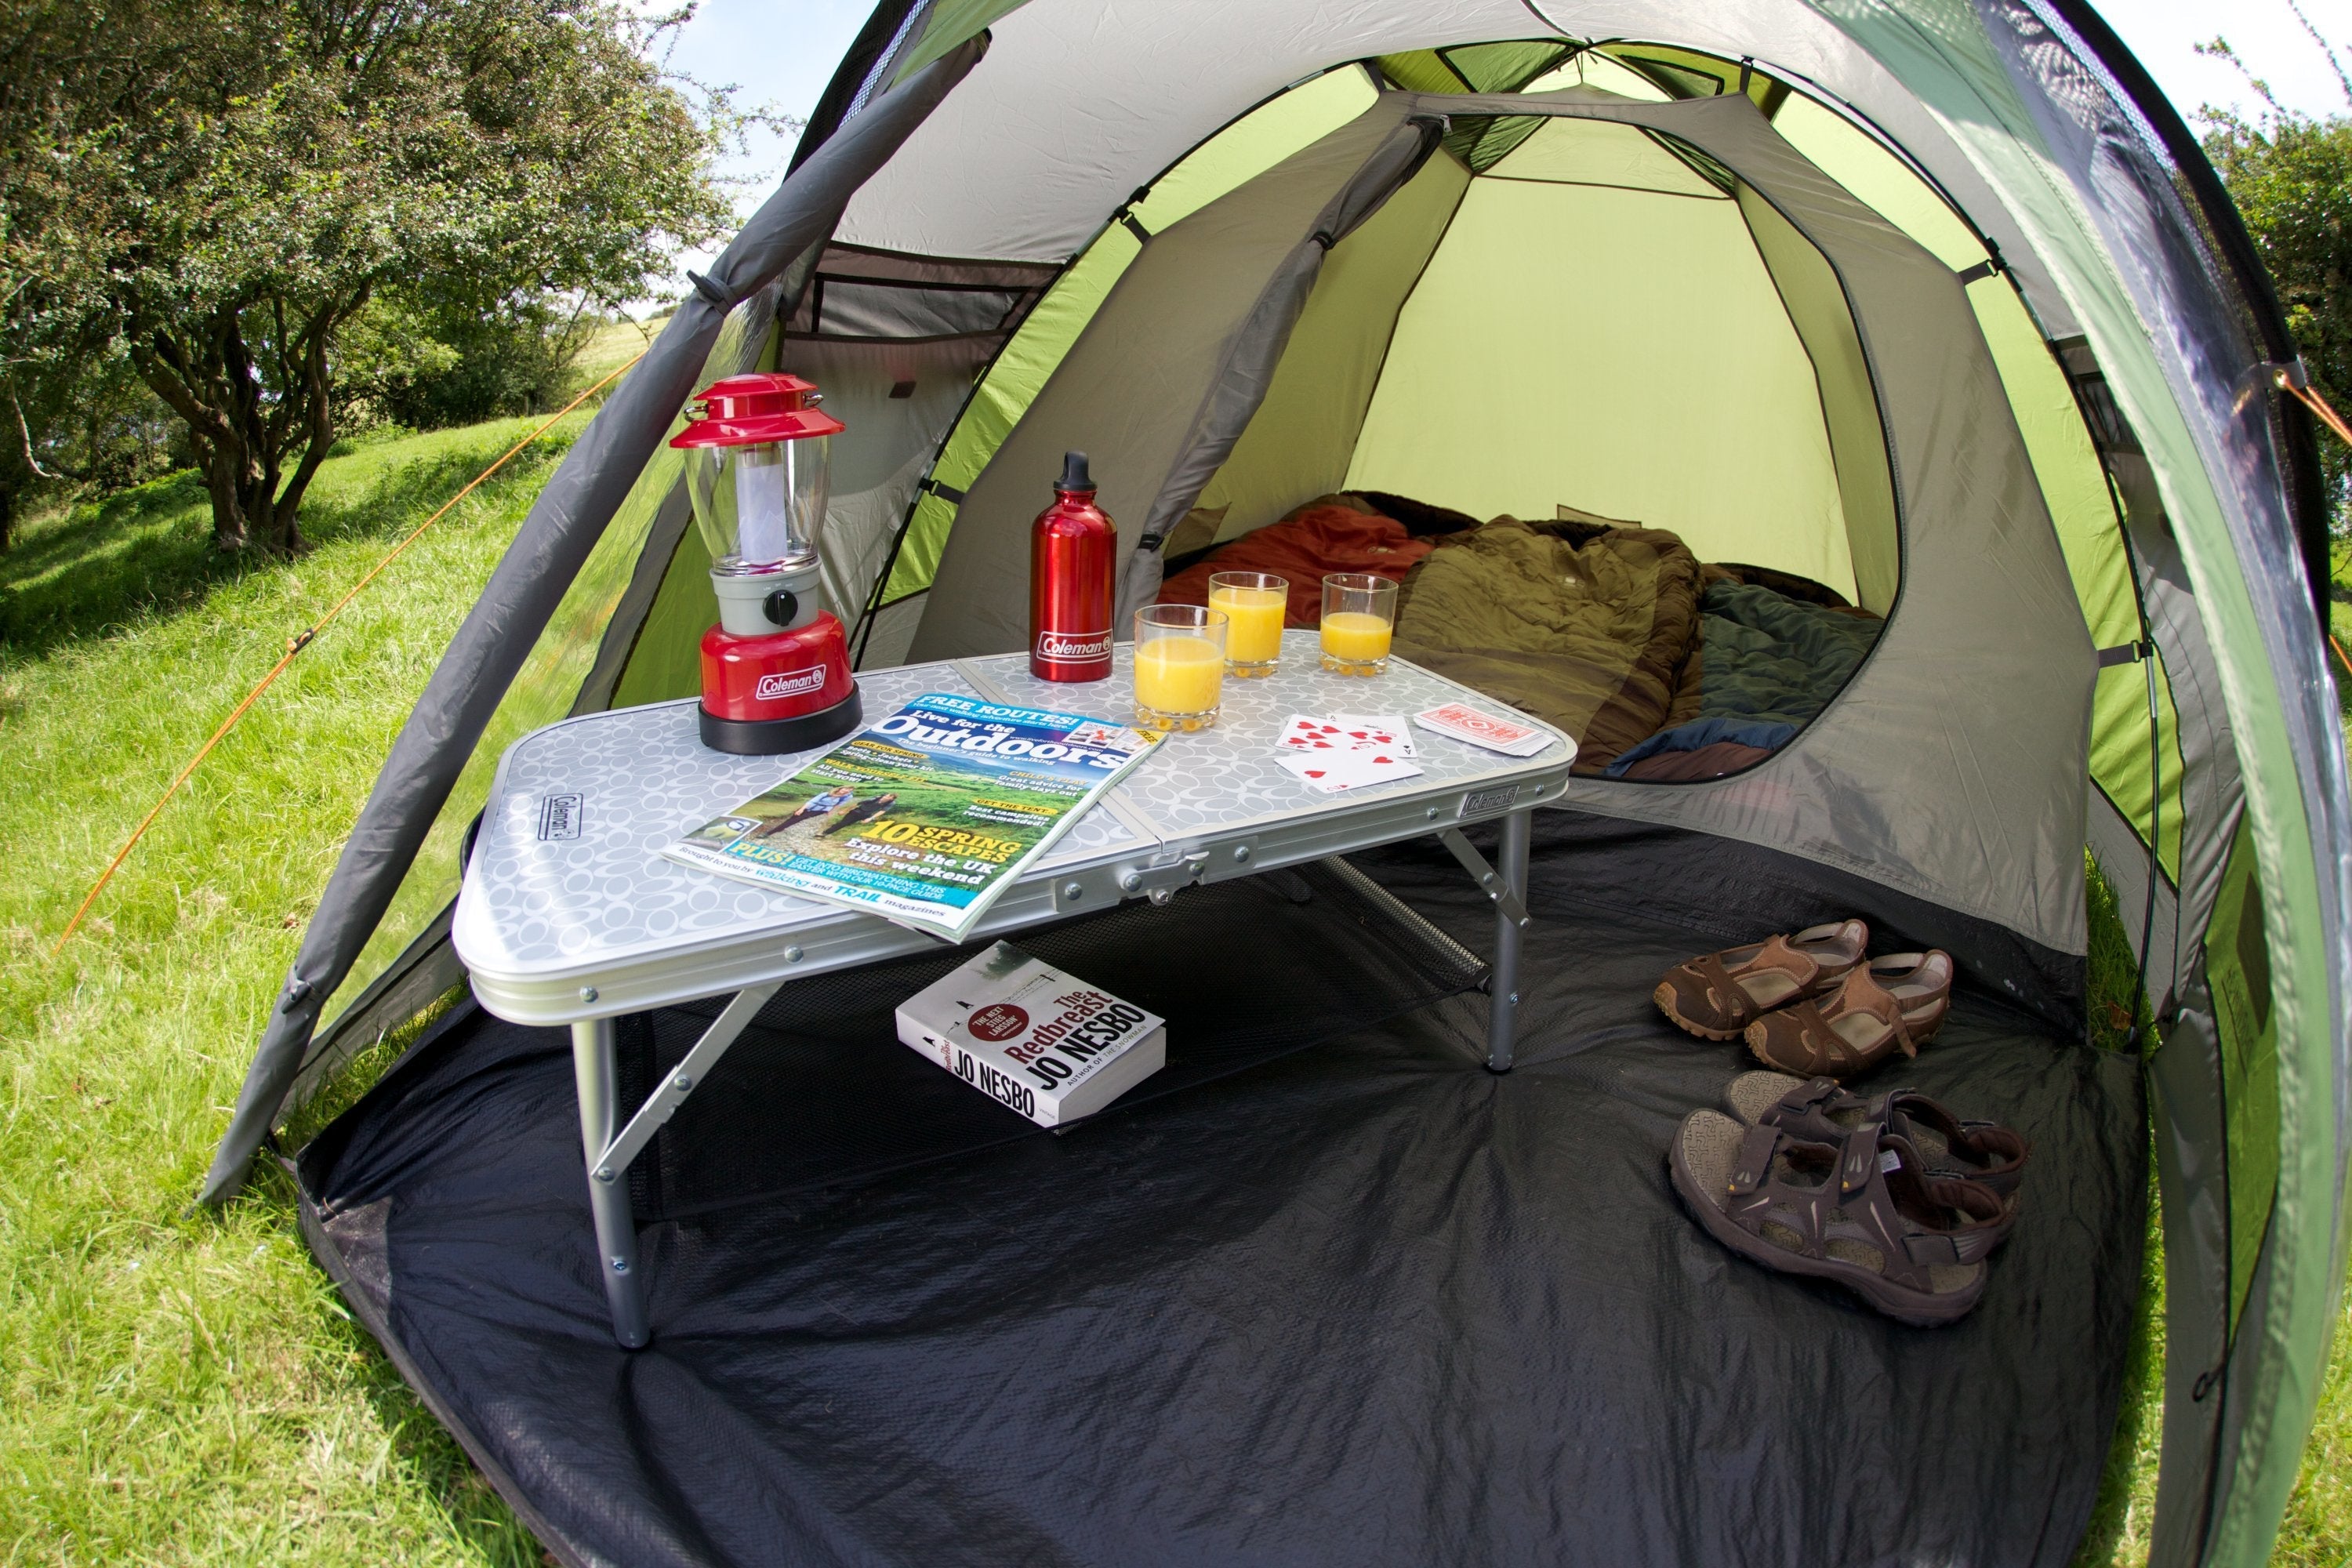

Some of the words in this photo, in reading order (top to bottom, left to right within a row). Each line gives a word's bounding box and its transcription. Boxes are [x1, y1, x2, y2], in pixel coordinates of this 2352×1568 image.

[1043, 637, 1102, 654] Coleman
[763, 676, 812, 694] Coleman
[916, 695, 976, 711] FREE
[975, 705, 1080, 726] ROUTES!
[949, 707, 981, 718] walking
[909, 710, 950, 724] Live
[951, 718, 983, 730] for
[983, 723, 1016, 734] the
[871, 715, 1128, 770] Outdoors
[1137, 730, 1158, 743] FREE
[846, 746, 871, 755] Boots
[878, 753, 913, 764] Jackets
[854, 741, 875, 750] GEAR
[893, 748, 924, 758] SPRING
[898, 737, 917, 746] The
[917, 740, 967, 754] beginner's
[967, 750, 998, 760] guide
[1014, 755, 1056, 766] walking
[825, 758, 855, 771] WALK
[855, 766, 908, 779] YOURSELF
[895, 760, 918, 770] your
[811, 768, 833, 778] start
[833, 773, 862, 783] NOW!
[851, 771, 873, 781] need
[999, 775, 1028, 785] Great
[1029, 779, 1065, 789] advice
[1009, 771, 1055, 782] CHILD'S
[1057, 778, 1088, 786] PLAY
[995, 780, 1030, 792] family
[1031, 785, 1057, 794] days
[1058, 789, 1078, 797] out
[977, 798, 996, 807] GET
[1466, 791, 1506, 810] Coleman
[551, 796, 577, 830] Coleman
[963, 811, 1046, 827] recommended!
[968, 804, 993, 813] Best
[994, 808, 1051, 822] campsites
[860, 820, 920, 843] 10
[918, 826, 1022, 854] SPRING
[730, 841, 794, 866] PLUS!
[844, 837, 920, 860] Explore
[924, 852, 958, 867] the
[962, 859, 998, 875] UK
[906, 836, 1011, 863] ESCAPES
[796, 857, 814, 866] GET
[815, 861, 840, 872] INTO
[840, 866, 920, 889] BIRDWATCHING
[921, 883, 946, 893] THIS
[848, 851, 887, 866] this
[891, 862, 985, 885] weekend
[679, 847, 713, 863] Brought
[713, 857, 723, 866] to
[723, 861, 741, 871] you
[741, 865, 753, 873] by
[811, 882, 833, 891] and
[833, 884, 884, 903] TRAIL
[884, 898, 946, 917] magazines
[789, 862, 824, 874] EASTER
[826, 869, 851, 880] WITH
[851, 874, 872, 884] OUR
[873, 879, 911, 893] 10-PAGE
[911, 889, 944, 900] GUIDE
[1054, 990, 1087, 1009] The
[986, 1006, 1004, 1018] NEXT
[986, 1014, 1006, 1028] STIEG
[1004, 989, 1113, 1065] Redbreast
[1026, 1056, 1073, 1091] JO
[1054, 1004, 1146, 1064] NESBO
[1067, 1065, 1094, 1087] AUTHOR
[1094, 1057, 1103, 1065] OF
[1102, 1048, 1116, 1058] THE
[1116, 1025, 1147, 1050] SNOWMAN
[954, 1049, 975, 1083] JO
[979, 1061, 1035, 1119] NESBO
